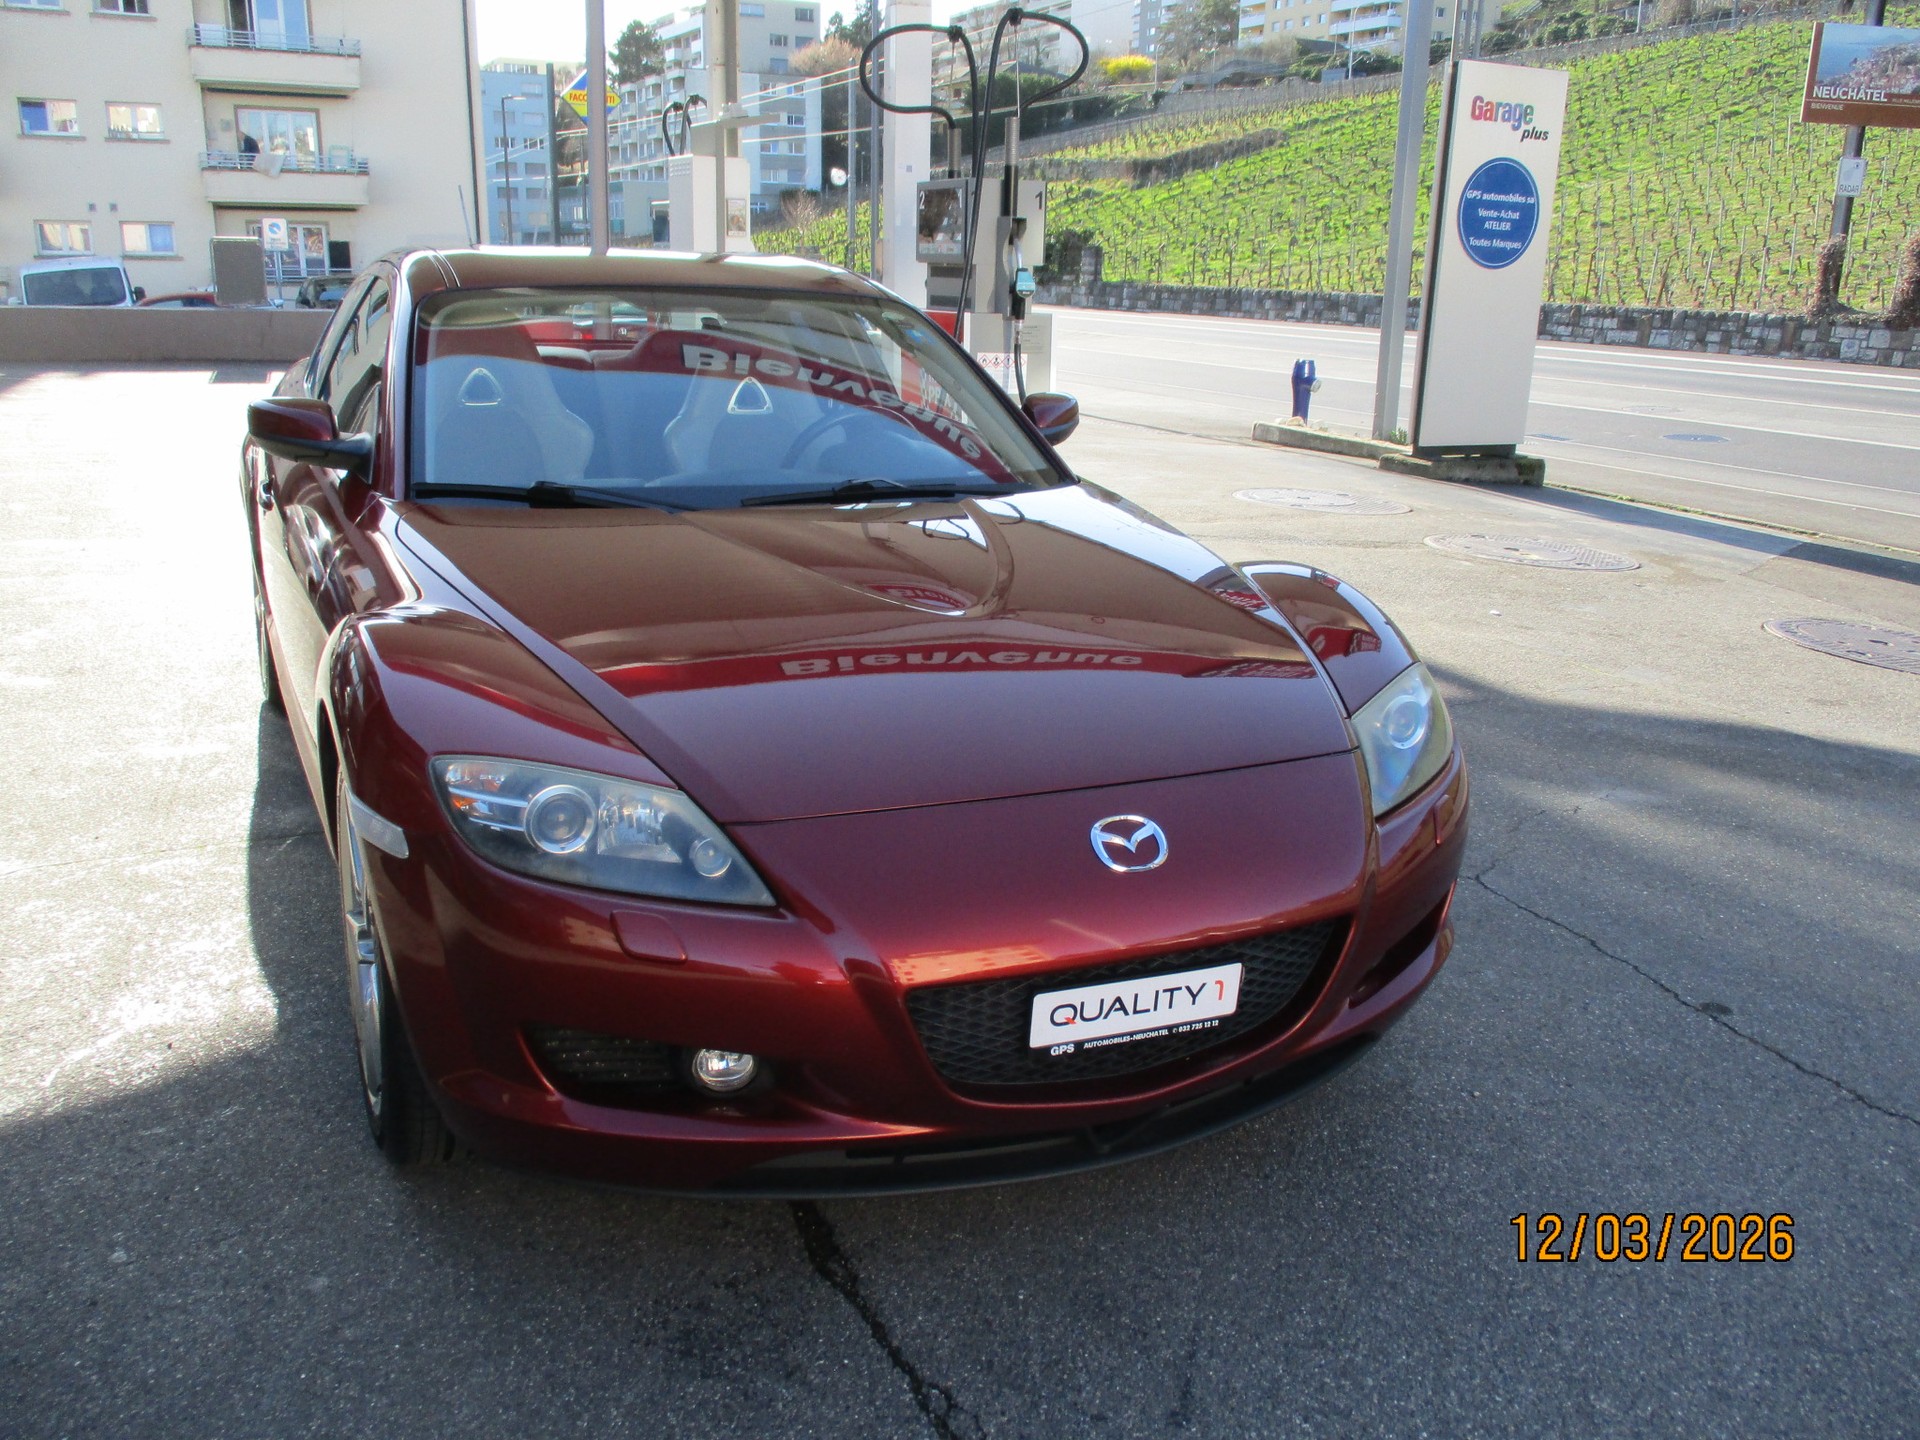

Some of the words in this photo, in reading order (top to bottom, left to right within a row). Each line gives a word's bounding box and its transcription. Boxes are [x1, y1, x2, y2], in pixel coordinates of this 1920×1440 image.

[1813, 85, 1888, 102] NEUCHÂTEL
[1470, 95, 1534, 131] Garage
[1811, 102, 1844, 111] BIENVENUE
[1520, 126, 1549, 143] plus
[1466, 190, 1482, 200] GPS
[1482, 193, 1526, 203] automobiles
[1839, 184, 1860, 193] RADAR
[919, 190, 925, 210] 2
[1034, 190, 1043, 210] 1
[1478, 208, 1520, 219] Vente-Achat
[1483, 220, 1511, 231] ATELIER
[1469, 236, 1491, 247] Toutes
[1492, 238, 1522, 250] Marques
[1049, 982, 1207, 1027] QUALITY
[1214, 979, 1225, 1001] 1
[1050, 1043, 1075, 1056] GPS
[1178, 1022, 1190, 1033] 032
[1204, 1021, 1211, 1029] 12
[1211, 1019, 1219, 1027] 12
